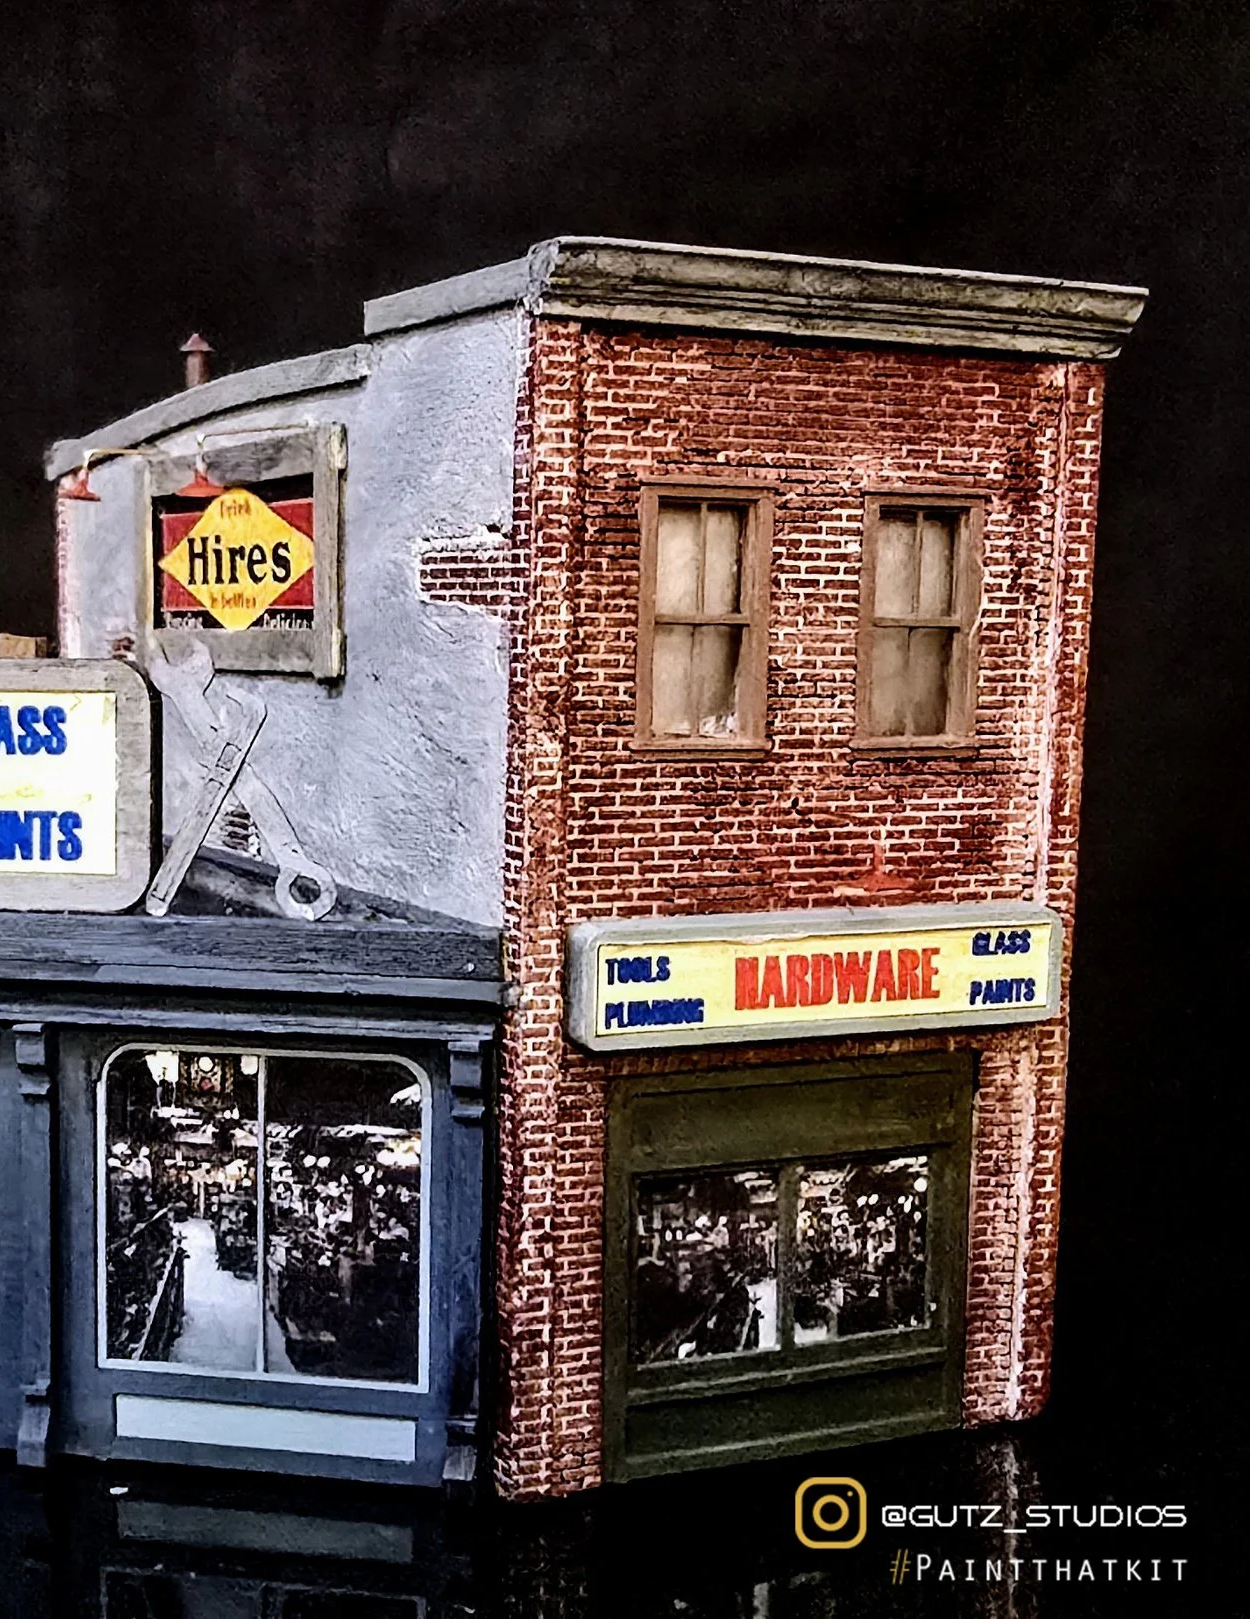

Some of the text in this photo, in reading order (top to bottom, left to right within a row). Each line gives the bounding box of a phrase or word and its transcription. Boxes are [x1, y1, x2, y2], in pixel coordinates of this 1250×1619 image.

[187, 534, 292, 585] Hires
[972, 929, 1031, 956] GLASS
[605, 956, 671, 985] TOOLS
[735, 947, 941, 1011] HARDWARE
[969, 977, 1036, 1005] PAINTS
[605, 998, 705, 1029] PLUMBING
